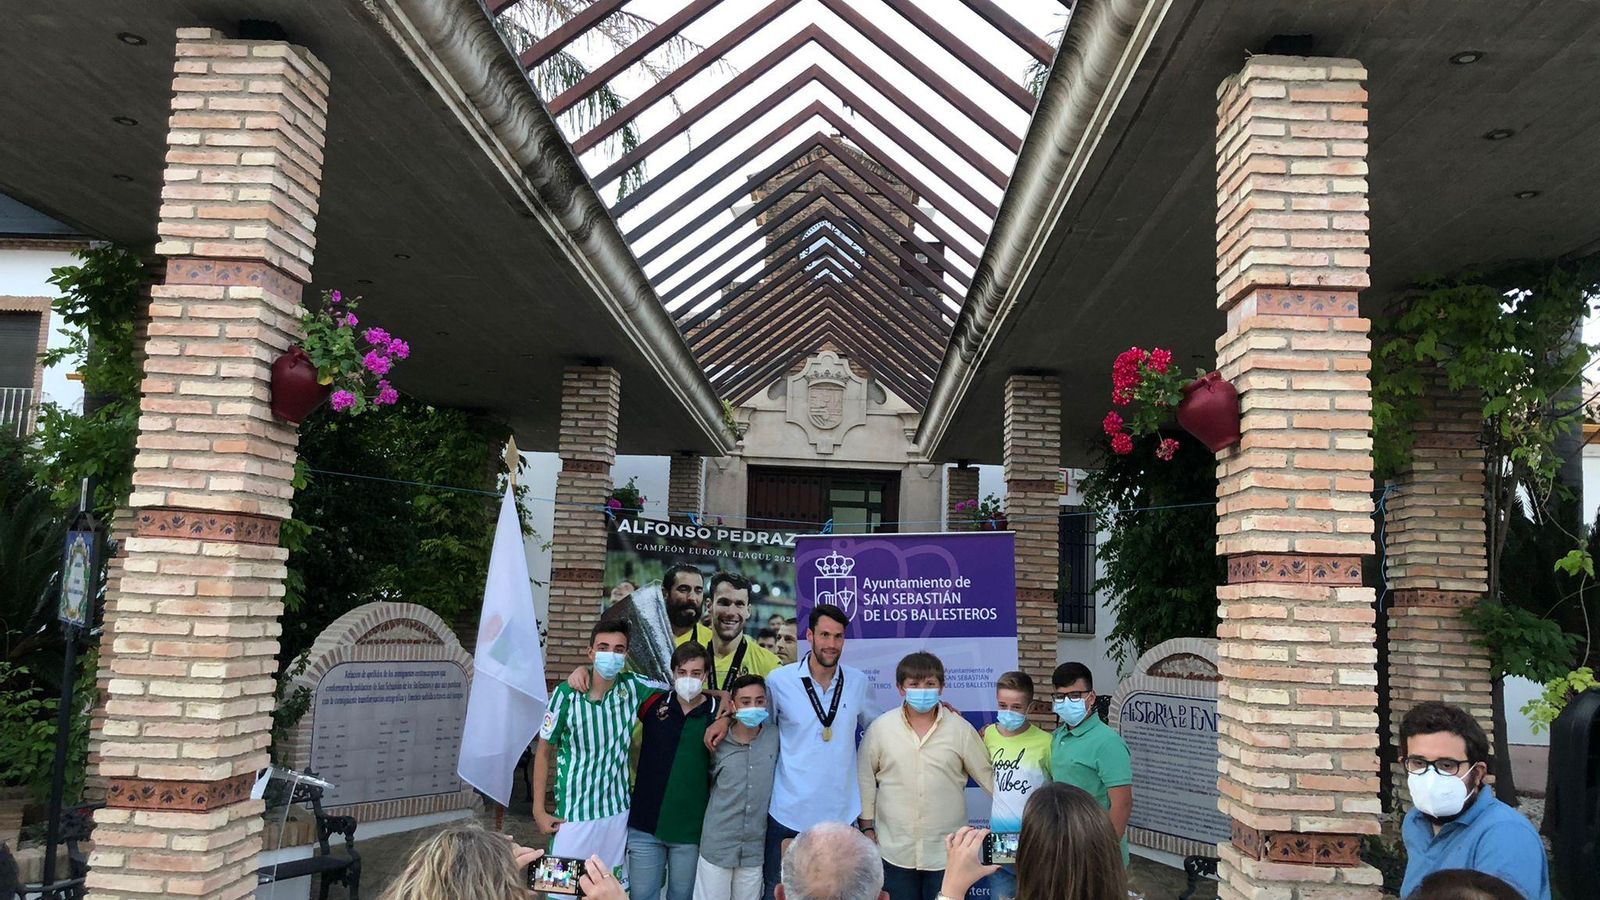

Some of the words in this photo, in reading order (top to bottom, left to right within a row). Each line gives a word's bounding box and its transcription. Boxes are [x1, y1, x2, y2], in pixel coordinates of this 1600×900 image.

[618, 518, 711, 540] ALFONSO
[717, 529, 797, 546] PEDRAZ
[635, 543, 685, 554] CAMPEÓN
[689, 547, 729, 558] EUROPA
[732, 551, 772, 562] LEAGUE
[774, 555, 796, 564] 2021
[863, 577, 952, 593] Ayuntamiento
[955, 576, 971, 588] de
[863, 592, 889, 606] SAN
[892, 590, 961, 605] SEBASTIÁN
[864, 609, 881, 622] DE
[883, 609, 907, 621] LOS
[911, 607, 998, 621] BALLESTEROS
[992, 748, 1026, 771] Good
[996, 770, 1032, 795] Vibes
